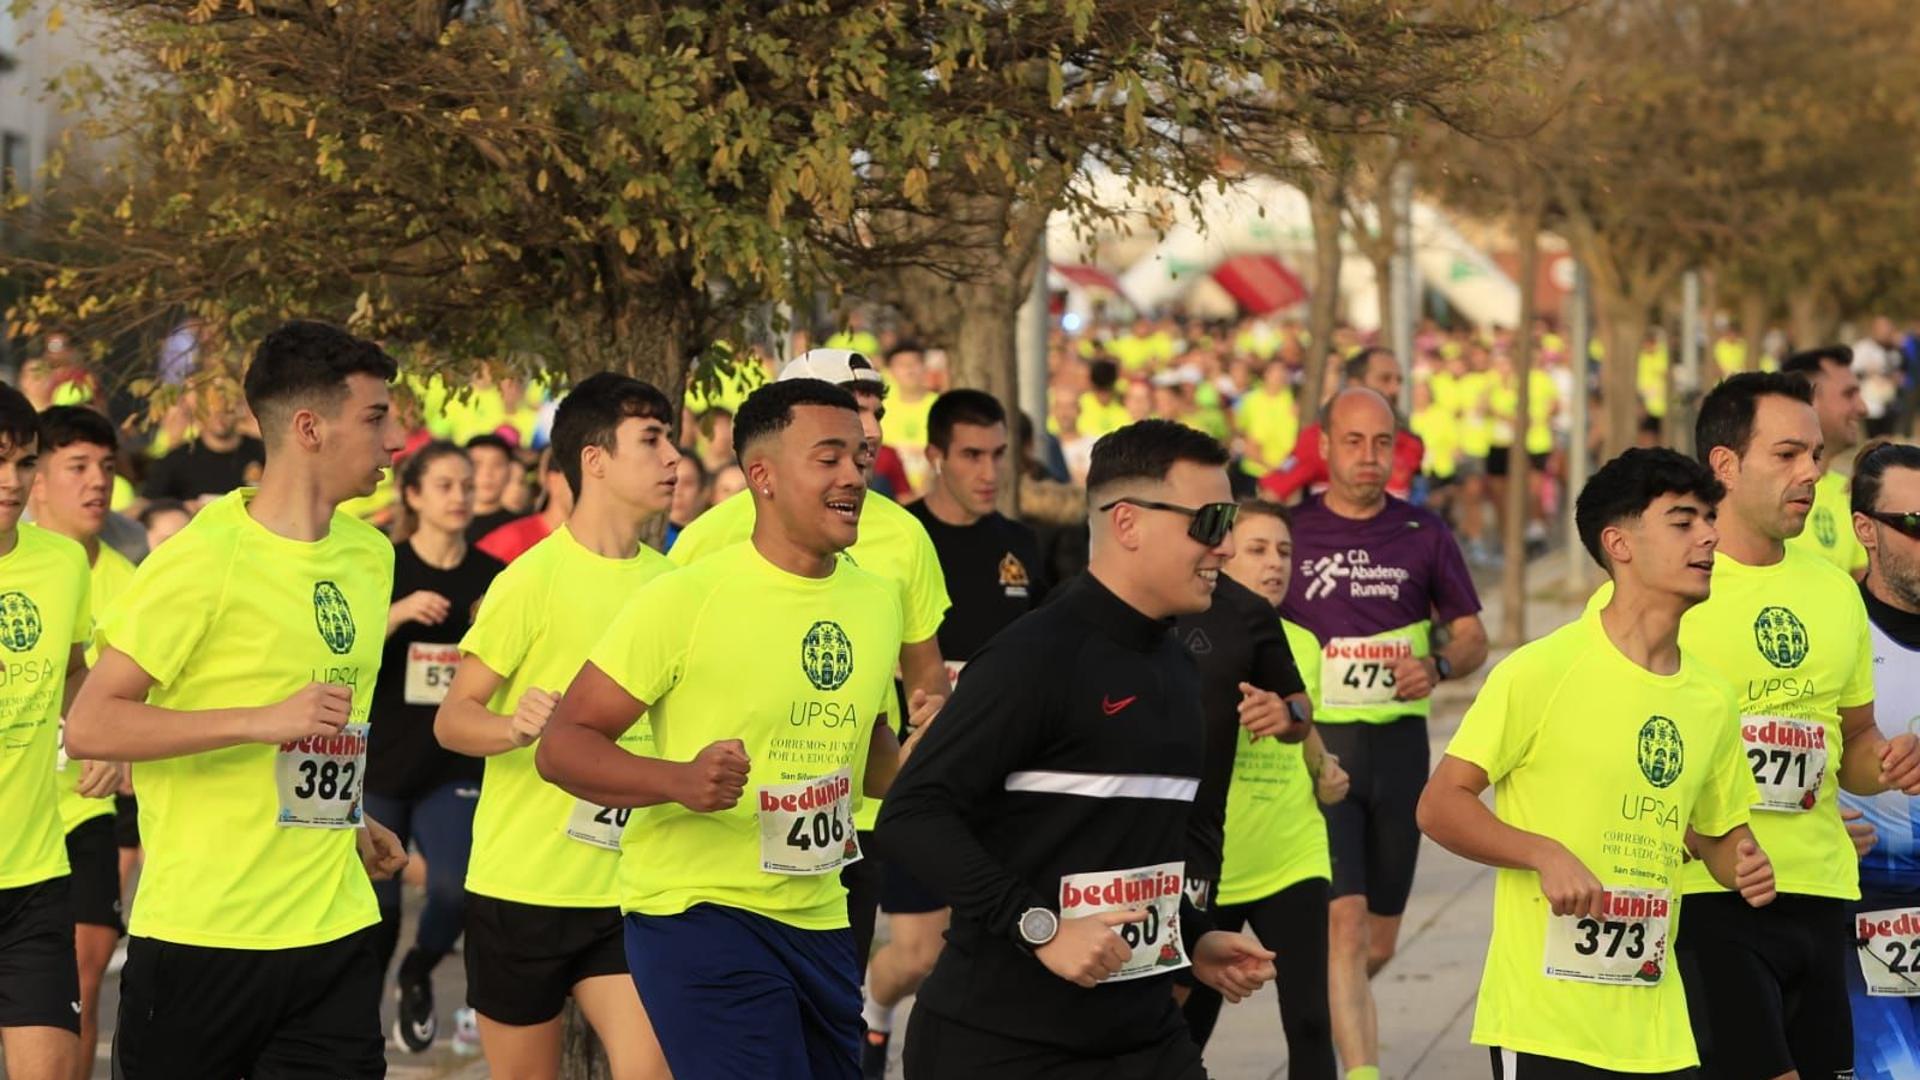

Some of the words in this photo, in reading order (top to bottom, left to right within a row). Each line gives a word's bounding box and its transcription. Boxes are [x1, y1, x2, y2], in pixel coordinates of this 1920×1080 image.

[1350, 581, 1400, 600] Running
[1748, 677, 1815, 701] UPSA
[790, 701, 858, 728] UPSA
[770, 738, 827, 750] CORREMOS
[1742, 721, 1825, 749] edunia
[768, 751, 789, 761] POR
[791, 752, 804, 763] LA
[1747, 748, 1806, 788] 271
[295, 760, 356, 800] 382
[760, 776, 850, 812] bedunia
[787, 806, 844, 851] 406
[1622, 794, 1679, 831] UPSA
[1062, 871, 1181, 908] bedunia
[1574, 919, 1645, 959] 373
